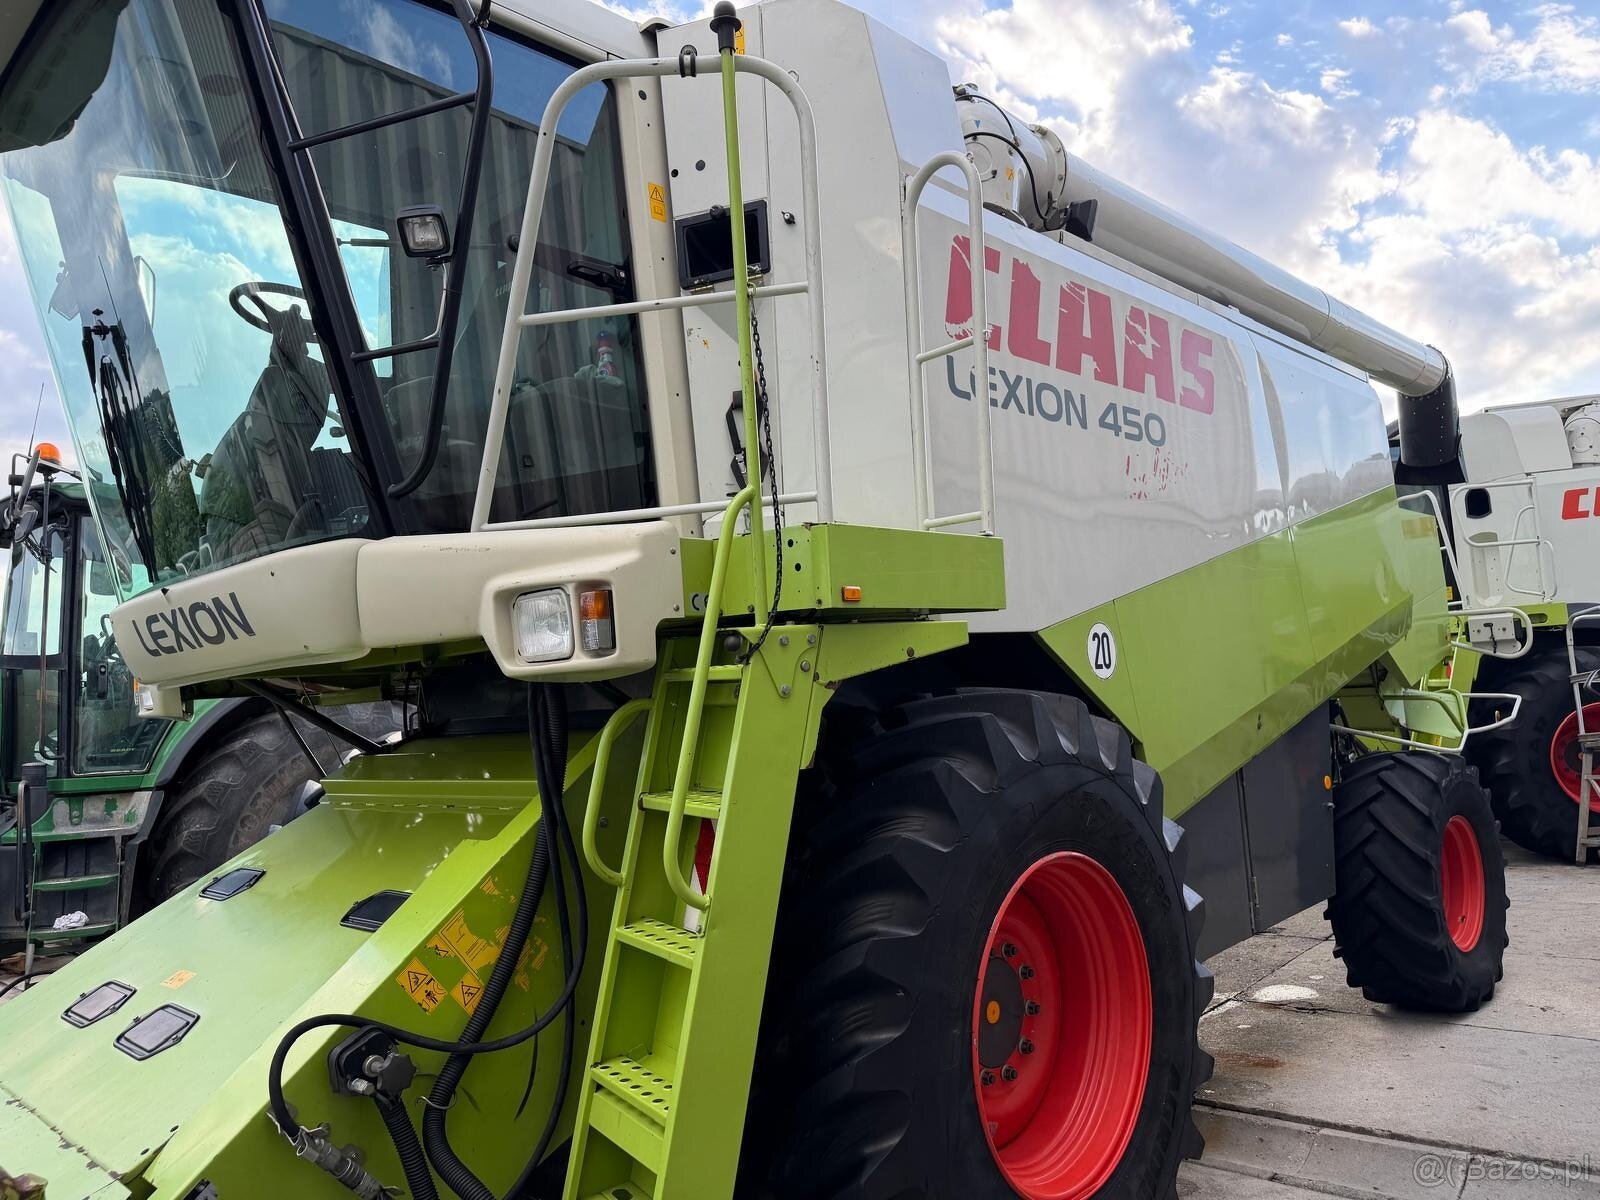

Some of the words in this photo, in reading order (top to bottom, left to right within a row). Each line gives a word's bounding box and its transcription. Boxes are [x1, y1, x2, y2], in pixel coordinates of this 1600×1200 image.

[945, 235, 1214, 415] CLAAS
[946, 354, 1088, 430] LEXION
[1099, 402, 1166, 447] 450
[132, 592, 256, 657] LEXION
[1092, 632, 1111, 669] 20
